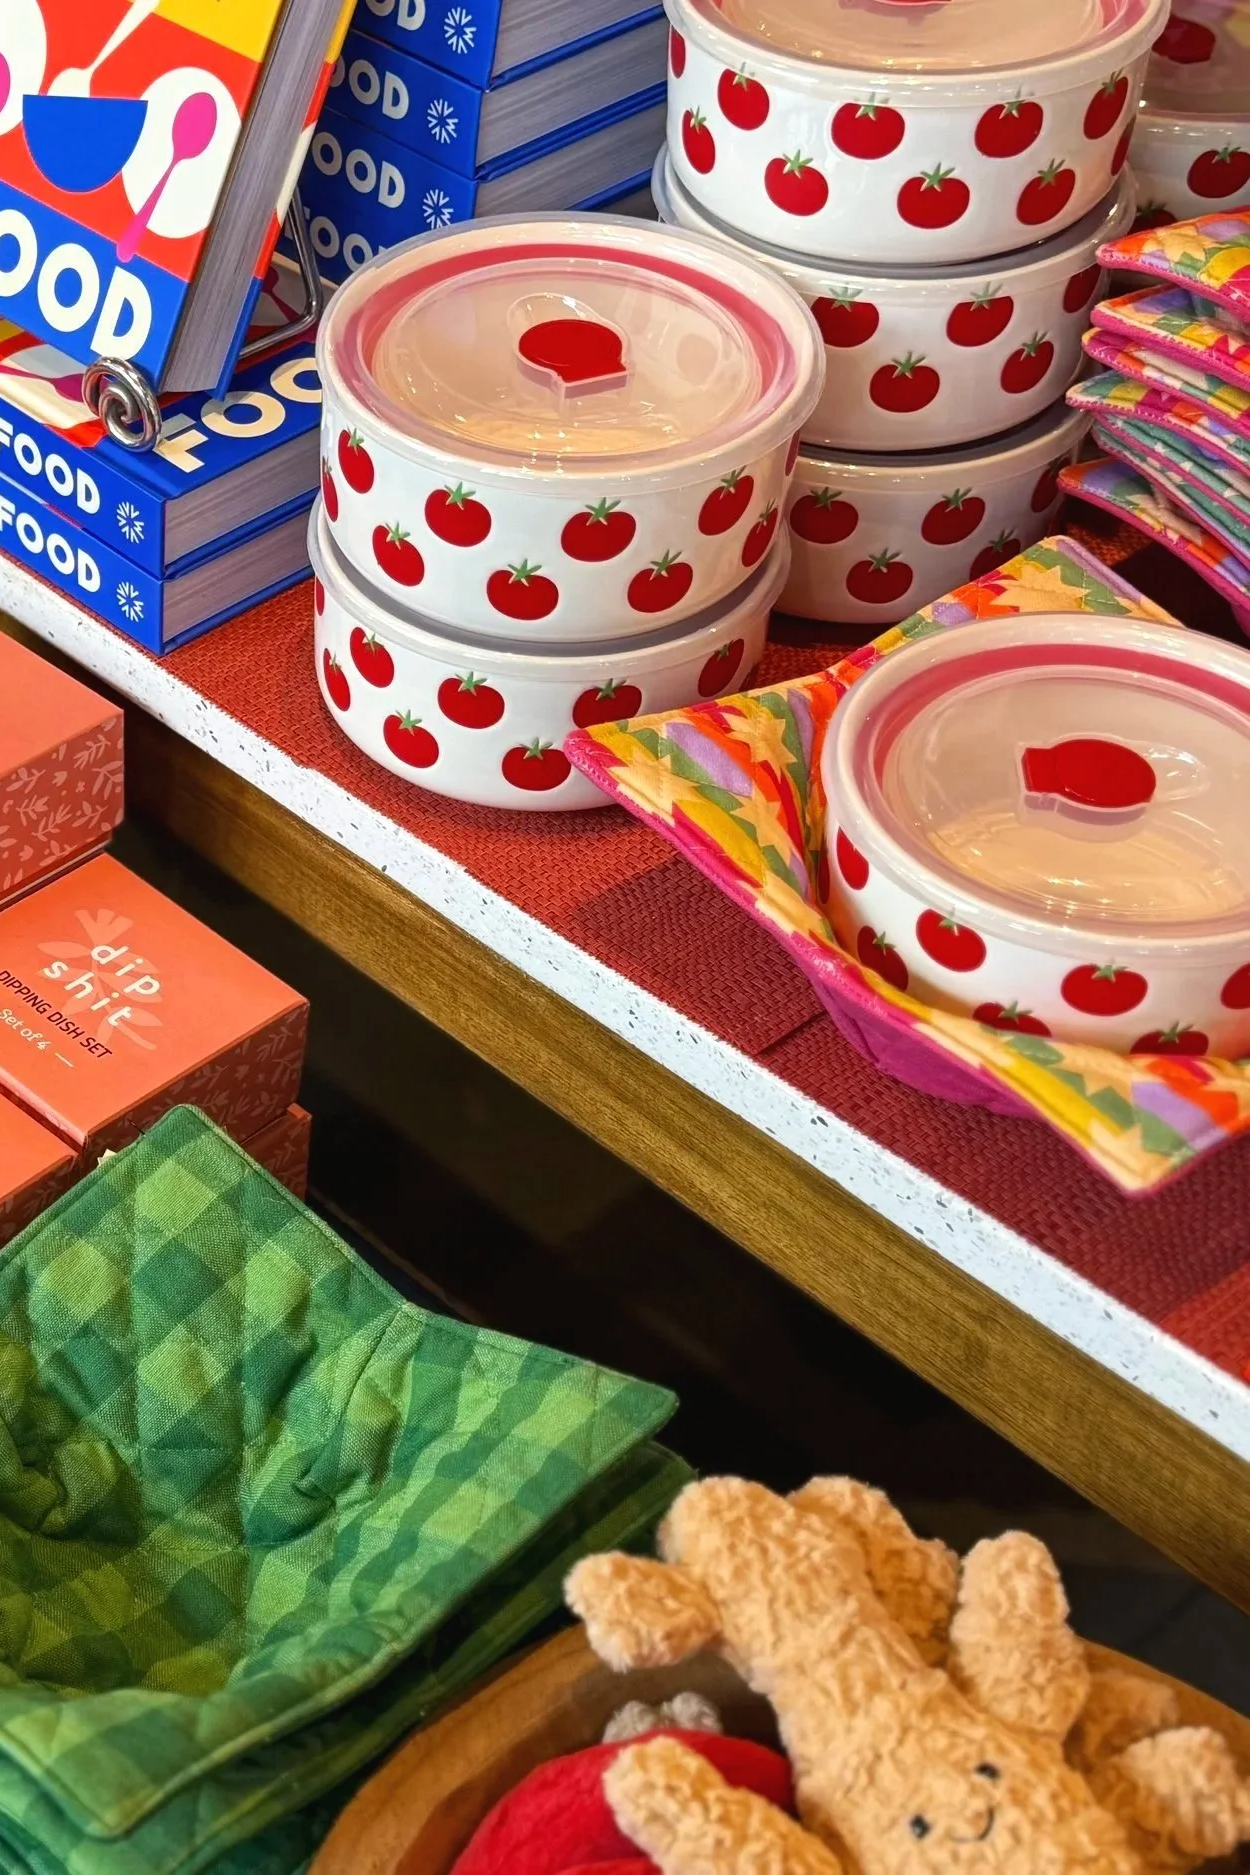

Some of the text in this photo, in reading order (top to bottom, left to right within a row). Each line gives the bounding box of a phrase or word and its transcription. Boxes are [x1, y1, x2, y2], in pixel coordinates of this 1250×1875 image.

[312, 132, 405, 208] OOD
[153, 357, 323, 473] FOO
[43, 961, 134, 1027] shit
[90, 944, 161, 995] dip
[20, 1026, 43, 1043] of
[36, 1040, 51, 1051] 4
[47, 1011, 85, 1039] DISH
[79, 1036, 113, 1058] SET
